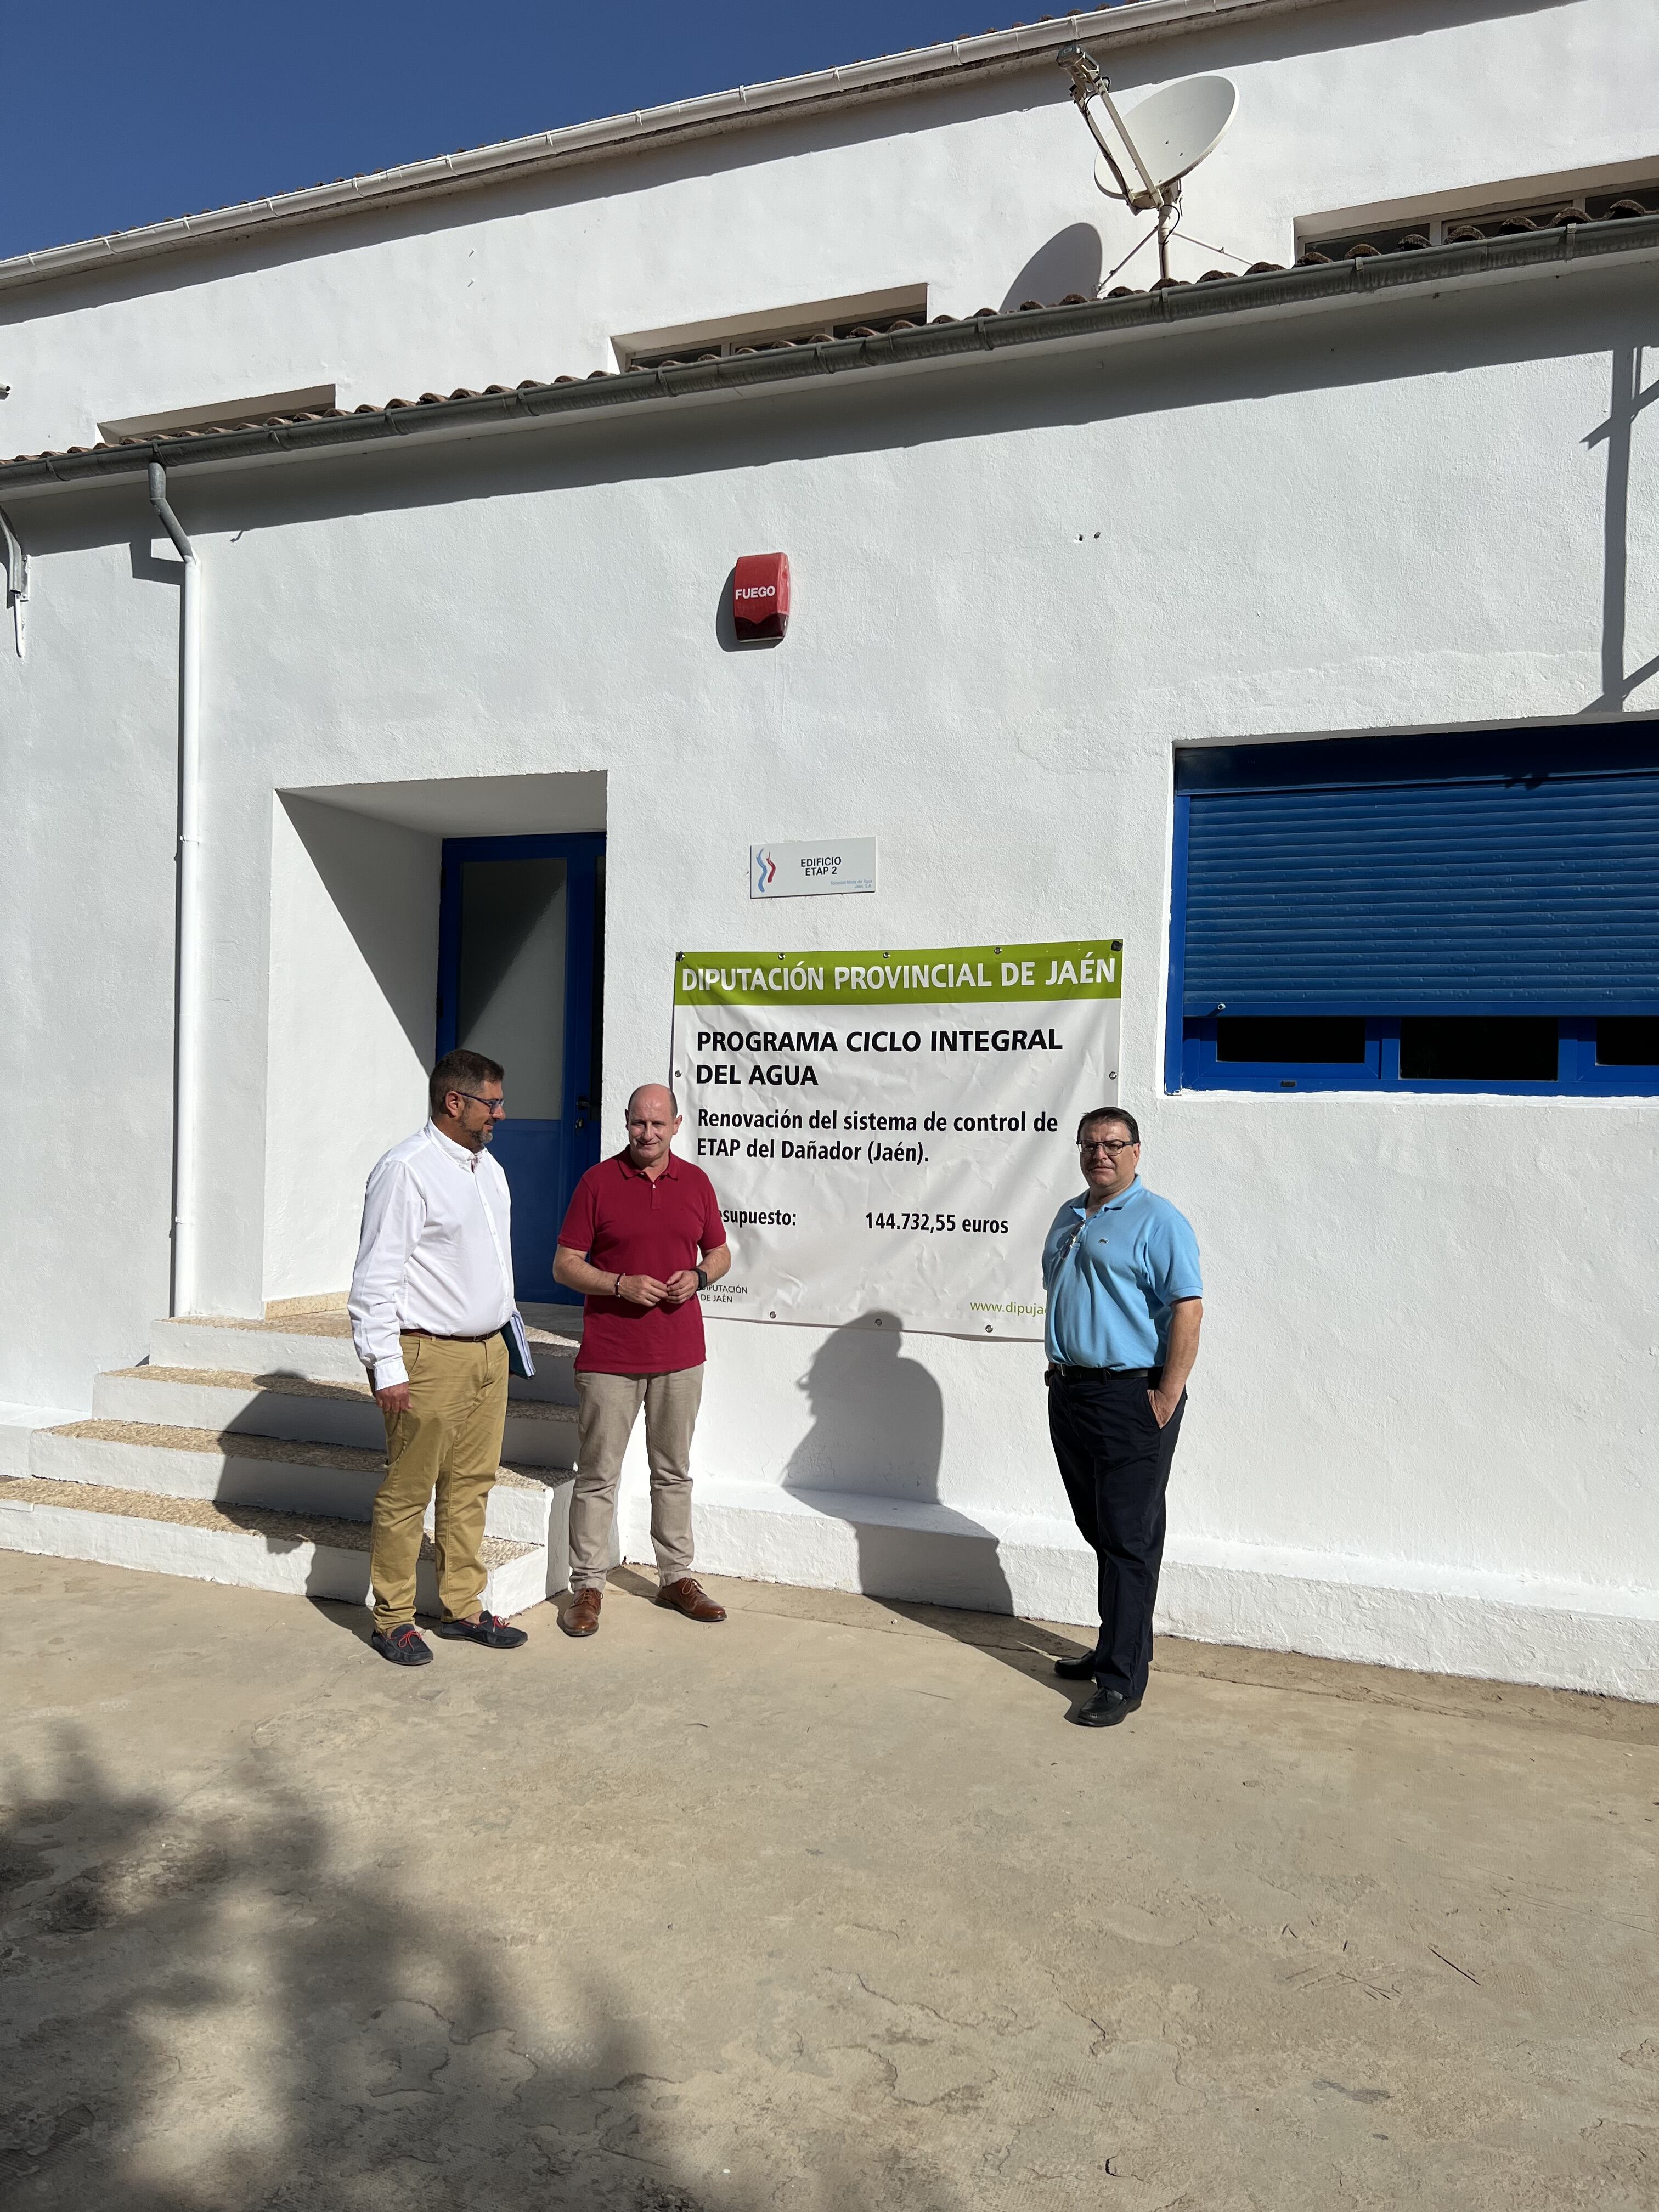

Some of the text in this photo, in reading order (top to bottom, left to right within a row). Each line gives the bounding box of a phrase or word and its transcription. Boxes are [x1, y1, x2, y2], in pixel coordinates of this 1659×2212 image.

[735, 586, 775, 600] FUEGO
[801, 857, 842, 867] EDIFICIO
[805, 867, 828, 876] ETAP
[682, 953, 1115, 991] DIPUTACIÓN PROVINCIAL DE JAÉN
[698, 1029, 1063, 1051] PROGRAMA CICLO INTEGRAL
[696, 1065, 819, 1085] DEL AGUA
[698, 1109, 1058, 1132] Renovación del sistema de control de
[698, 1139, 929, 1163] ETAP del Dañador (Jaén).
[719, 1210, 1009, 1233] supuesto: 144.732,55 euros
[713, 1294, 732, 1303] JAÉN
[970, 1302, 1046, 1316] www.dipuja
